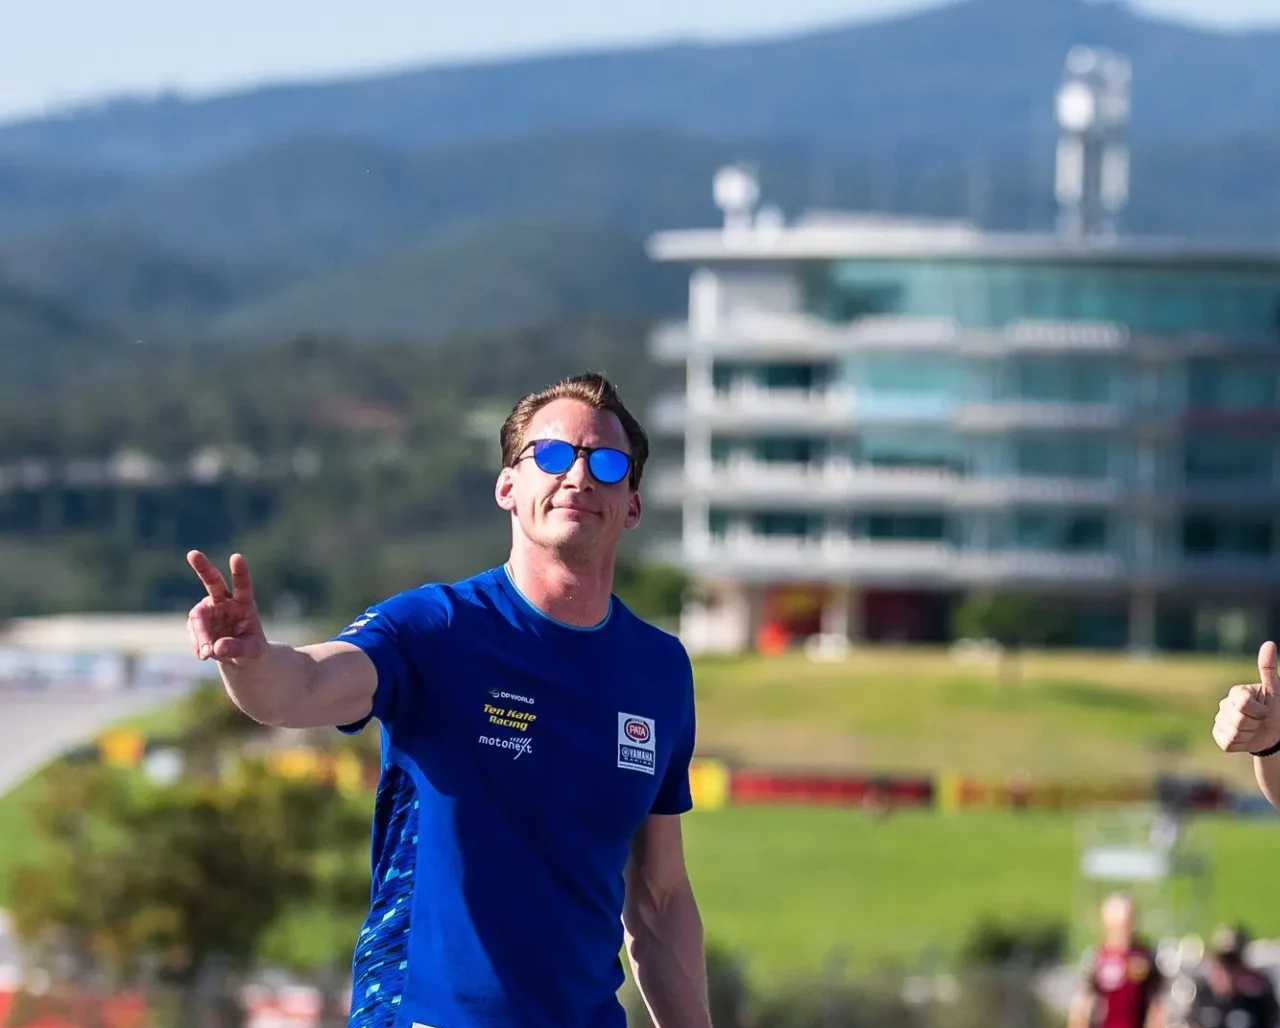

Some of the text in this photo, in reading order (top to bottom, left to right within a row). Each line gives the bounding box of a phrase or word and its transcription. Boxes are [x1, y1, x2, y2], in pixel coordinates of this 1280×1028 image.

[510, 694, 535, 704] WORLD
[483, 703, 537, 722] Ten Kate
[489, 715, 529, 731] Racing
[629, 724, 646, 737] PATA
[478, 735, 533, 760] motonext
[629, 748, 653, 762] YAMAHA
